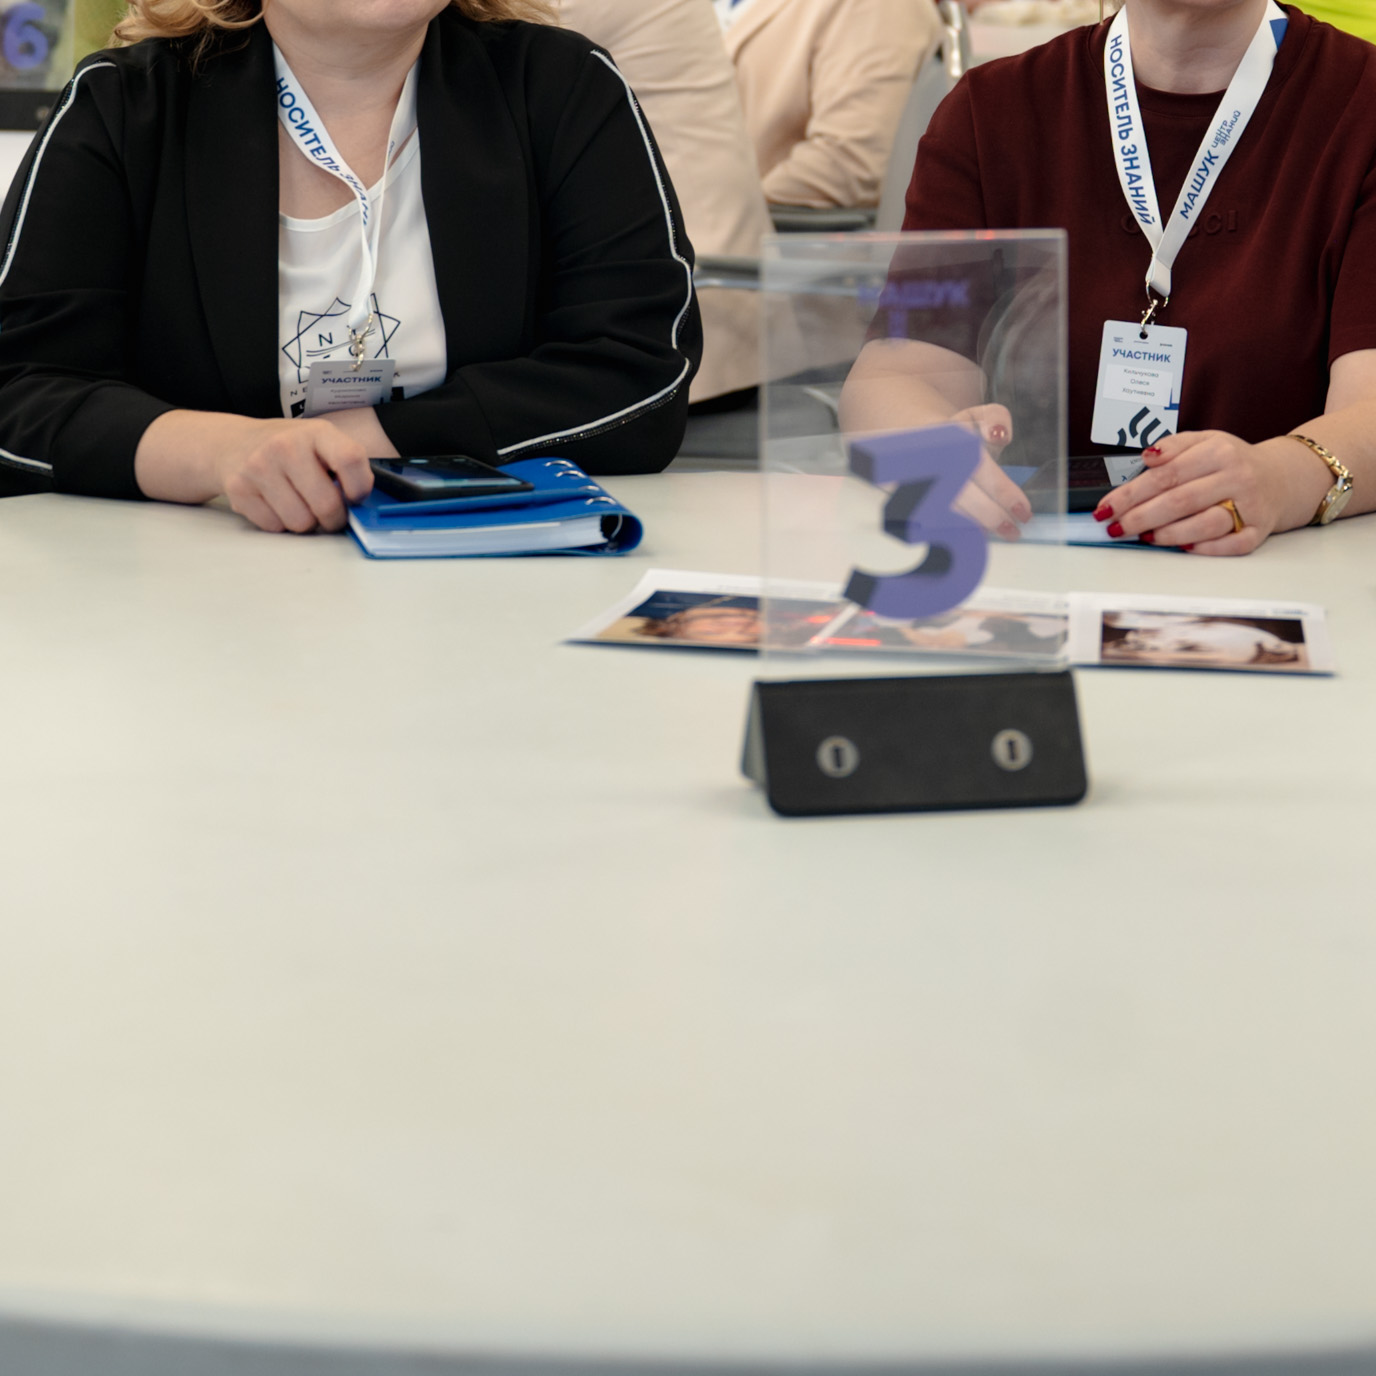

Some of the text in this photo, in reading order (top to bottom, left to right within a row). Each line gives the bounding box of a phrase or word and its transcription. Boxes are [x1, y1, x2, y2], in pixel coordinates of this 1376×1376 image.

[0, 1, 51, 70] 6
[276, 76, 340, 172] НОСИТЕЛЬ
[1109, 33, 1156, 226] НОСИТЕЛЬ ЗНАНИЙ
[1179, 149, 1220, 220] МАШУК
[321, 376, 382, 384] УЧАСТНИК
[1112, 348, 1172, 363] УЧАСТНИК
[843, 422, 989, 620] 3
